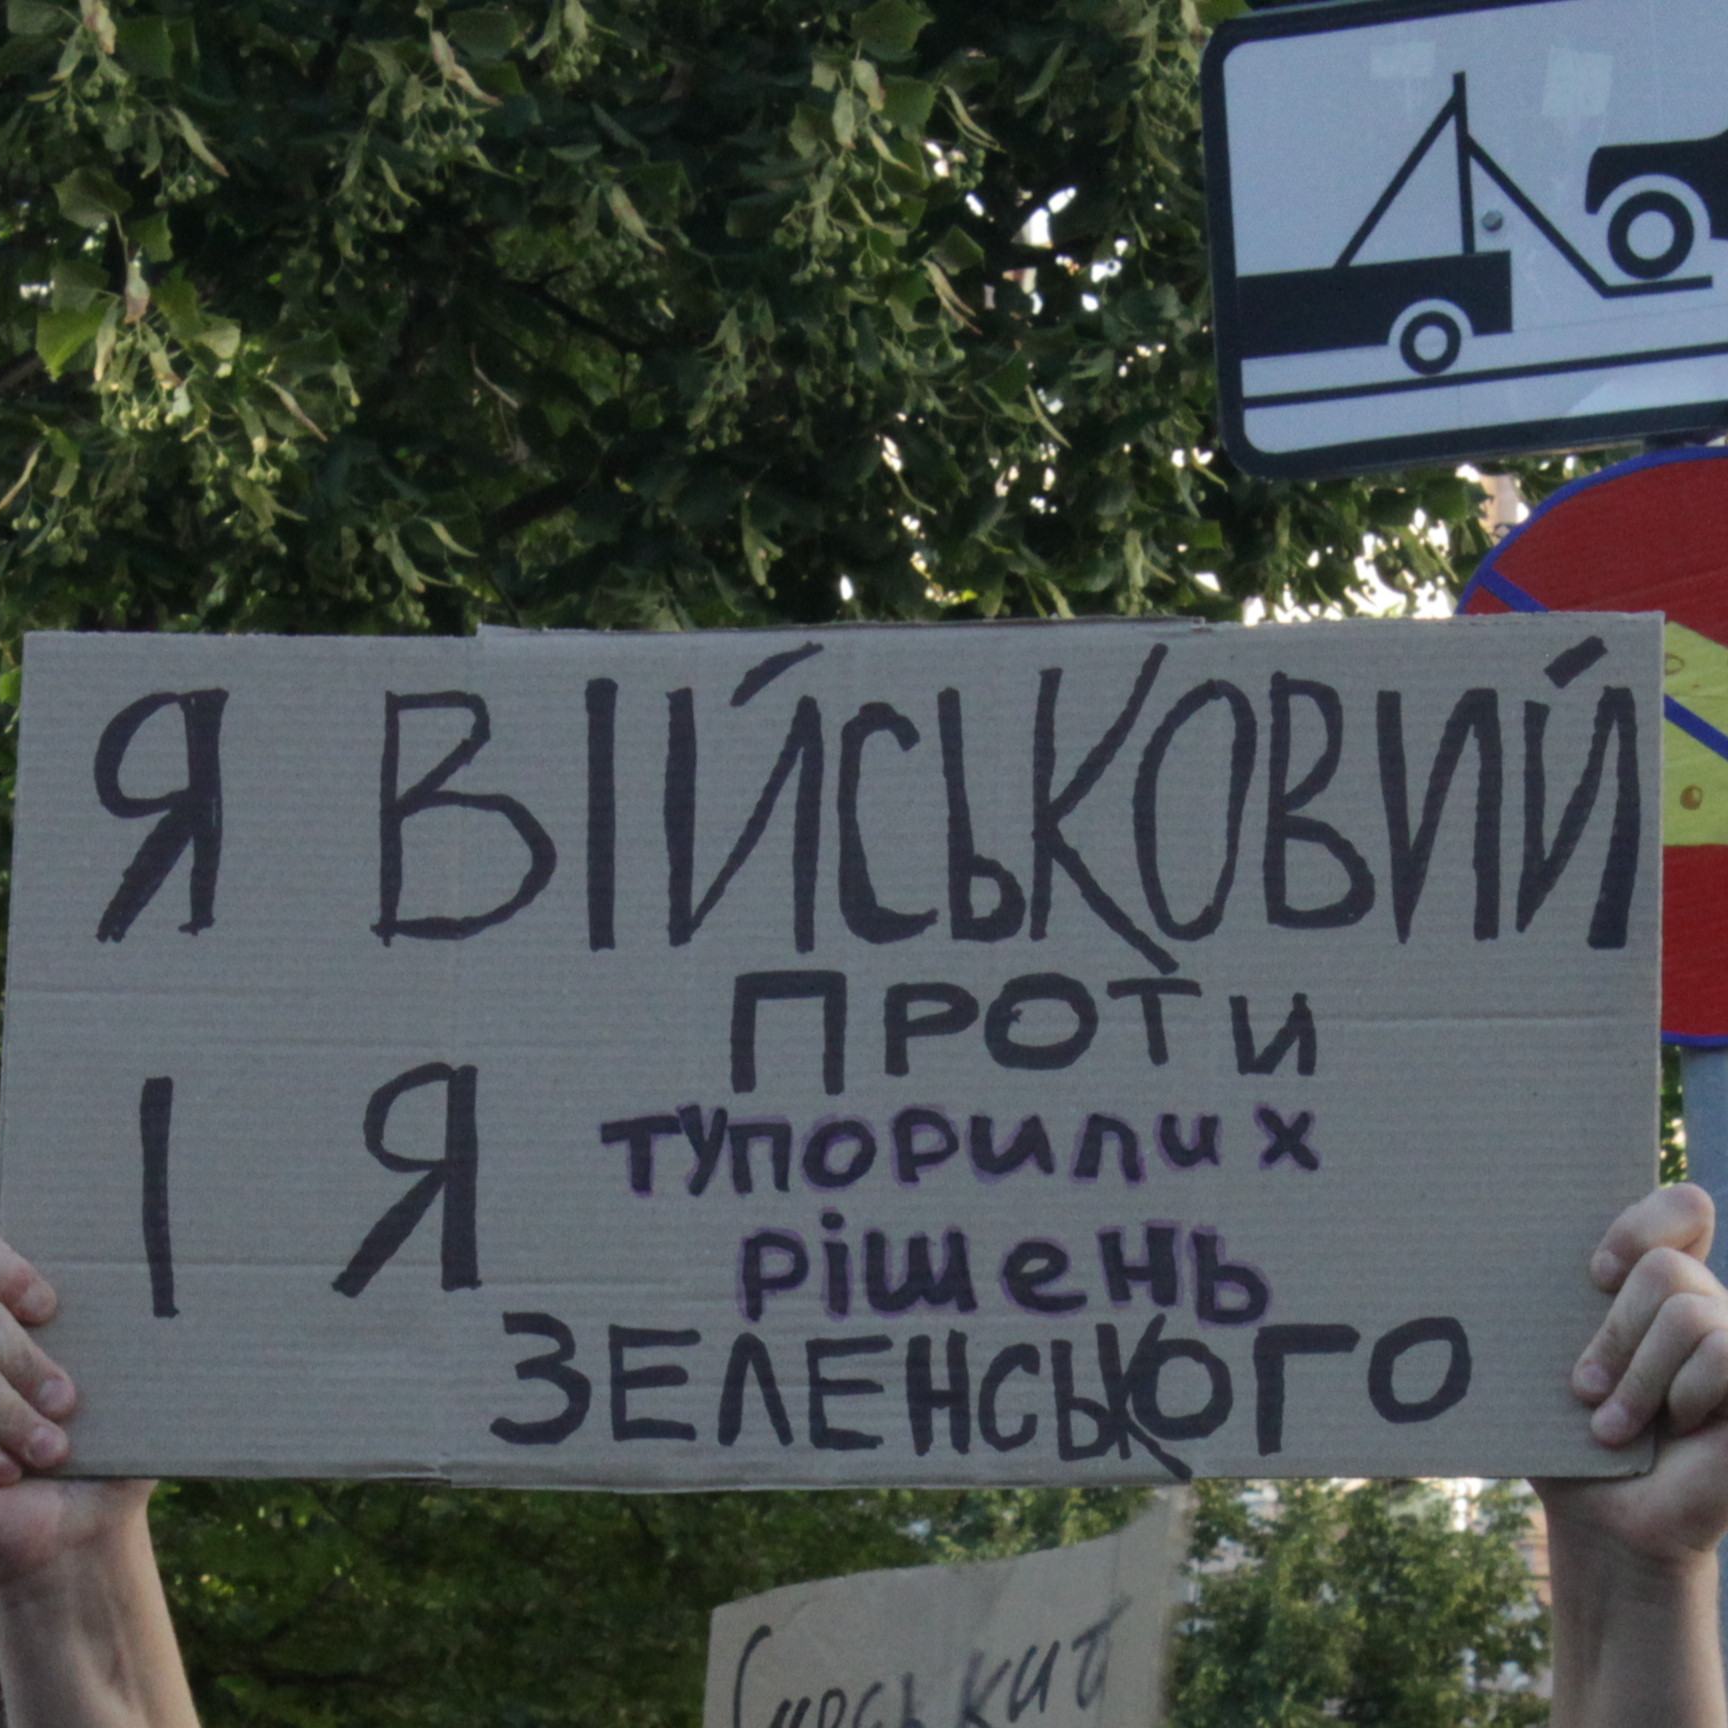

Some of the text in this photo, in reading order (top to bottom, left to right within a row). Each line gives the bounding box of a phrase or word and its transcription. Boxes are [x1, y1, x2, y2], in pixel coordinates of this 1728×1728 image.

[91, 635, 1642, 975] Я ВІЙСЬКОВИЙ
[731, 970, 1319, 1094] ПРОТИ
[331, 1061, 482, 1298] Я
[488, 1307, 1475, 1481] ЗЕЛЕНСЬКОГО
